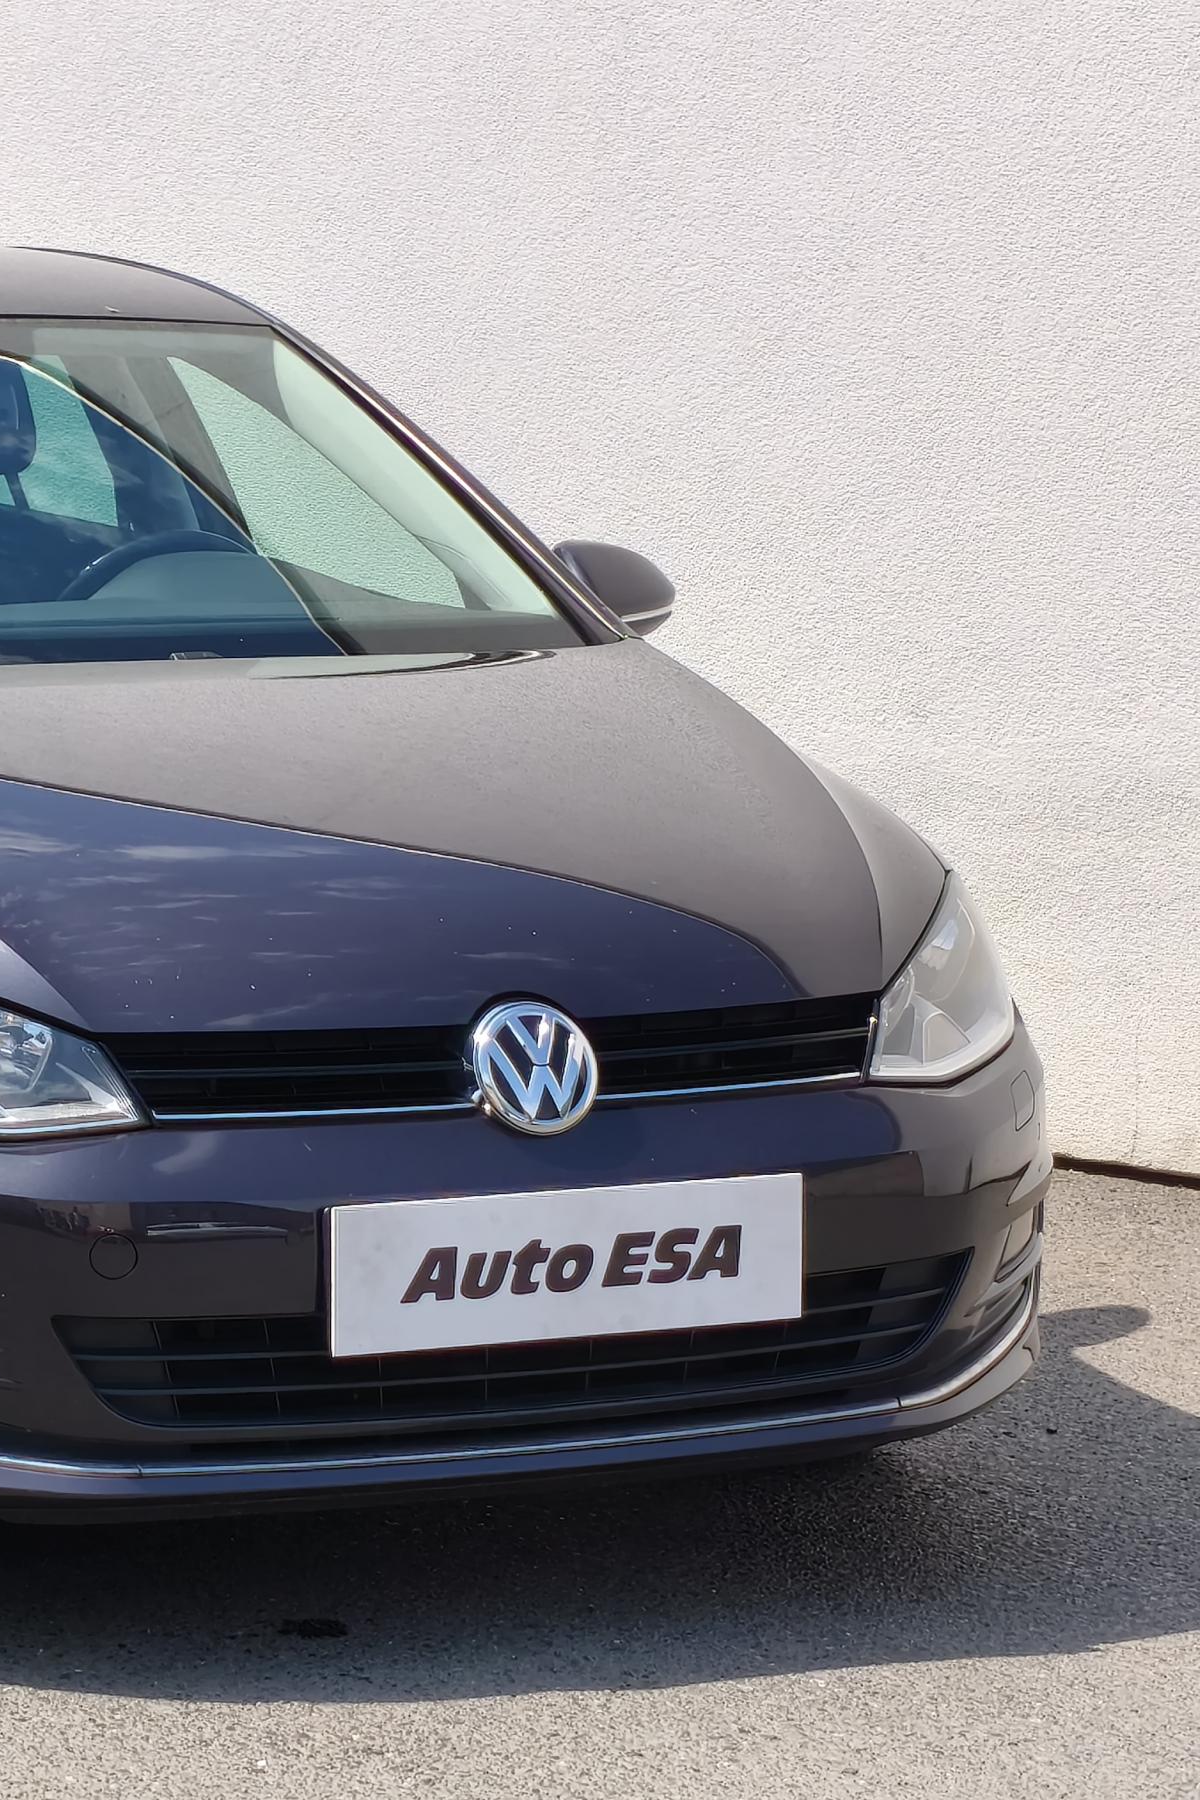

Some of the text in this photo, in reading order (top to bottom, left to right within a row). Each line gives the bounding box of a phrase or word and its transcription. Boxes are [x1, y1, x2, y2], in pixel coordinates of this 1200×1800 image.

[476, 1005, 596, 1132] VW
[400, 1225, 742, 1303] Auto ESA
